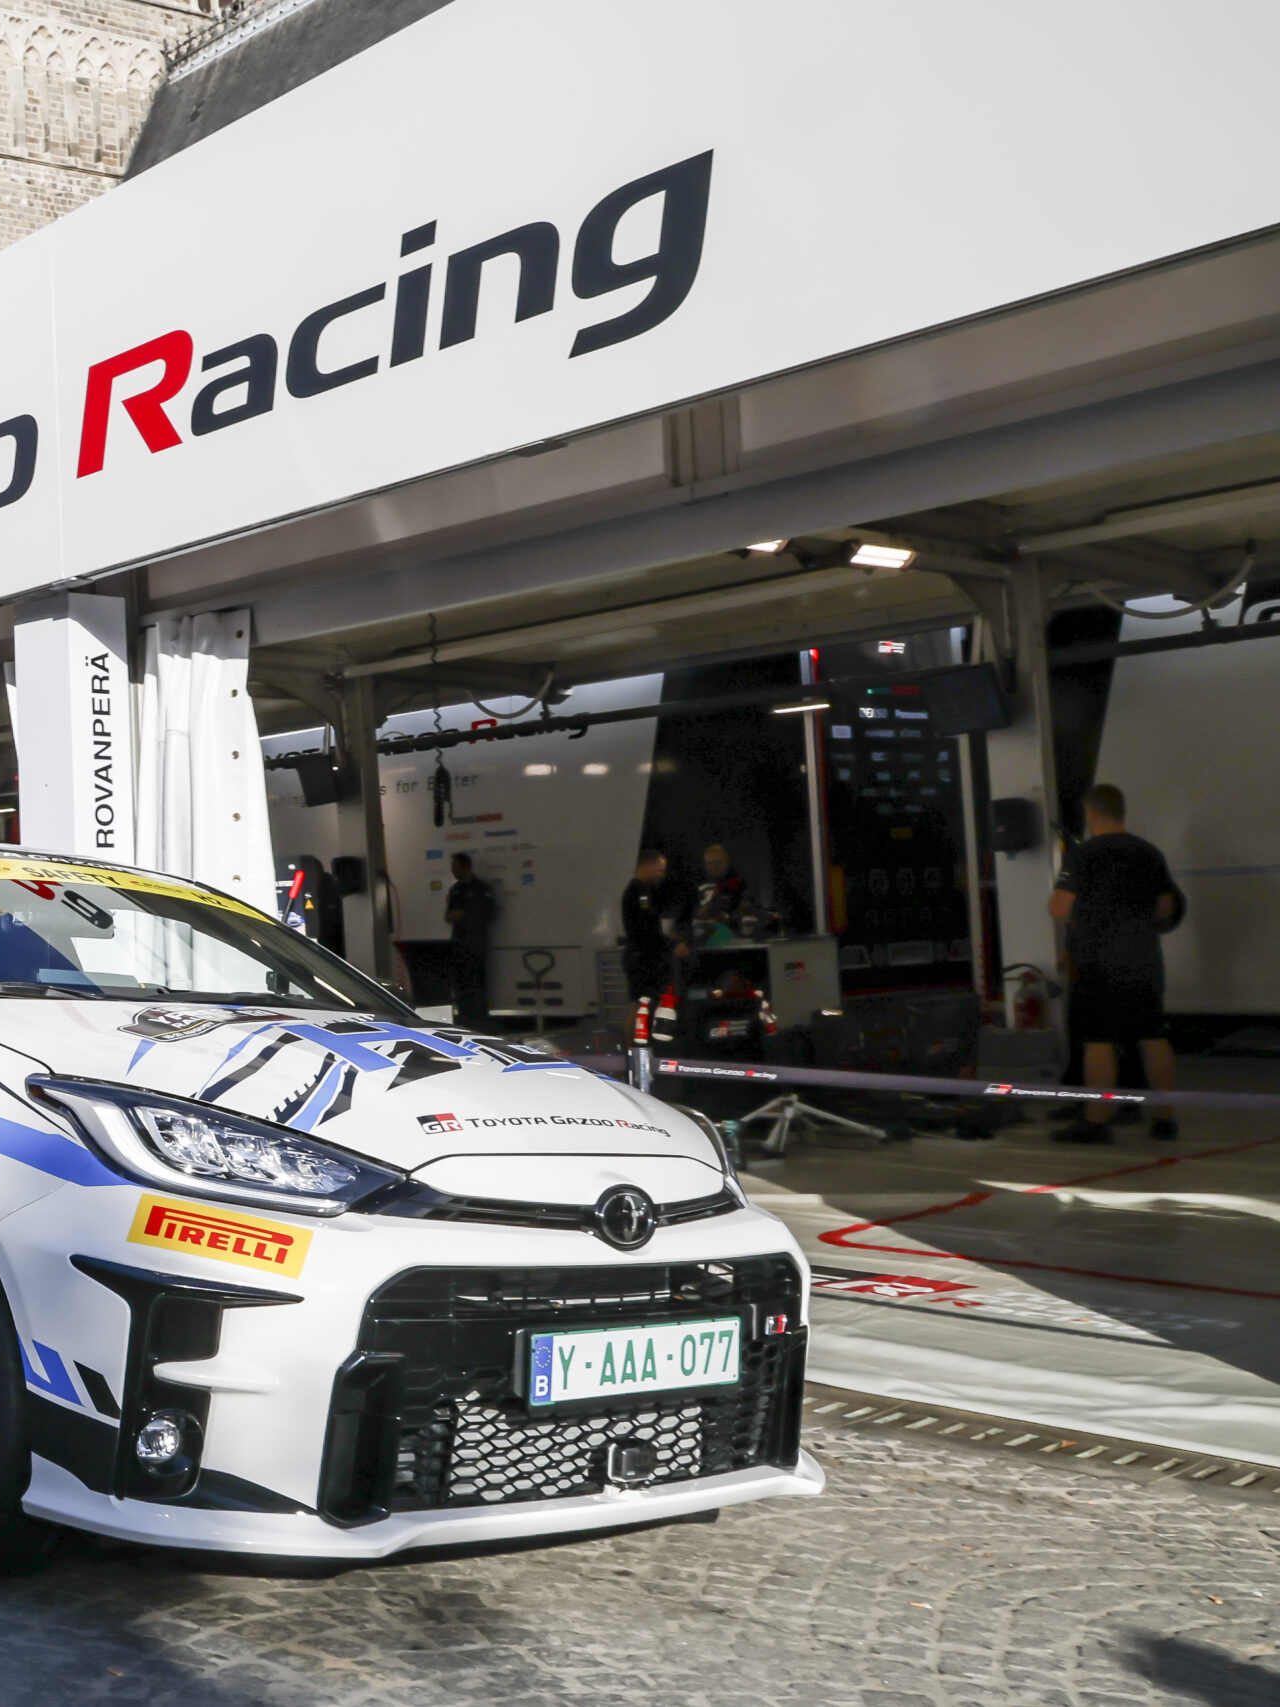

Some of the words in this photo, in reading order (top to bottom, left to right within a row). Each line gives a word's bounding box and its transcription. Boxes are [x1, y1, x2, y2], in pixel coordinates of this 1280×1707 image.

[76, 149, 715, 479] Racing
[85, 652, 116, 849] ROVANPERÄ
[427, 773, 479, 791] Bter
[22, 866, 121, 886] SAFETY
[422, 1119, 463, 1135] GR
[465, 1117, 547, 1128] TOYOTA
[550, 1115, 615, 1127] GAZOO
[615, 1119, 671, 1138] Racing
[144, 1205, 294, 1265] PIRELLI
[534, 1375, 549, 1397] B
[558, 1329, 735, 1391] Y-AAA-077
